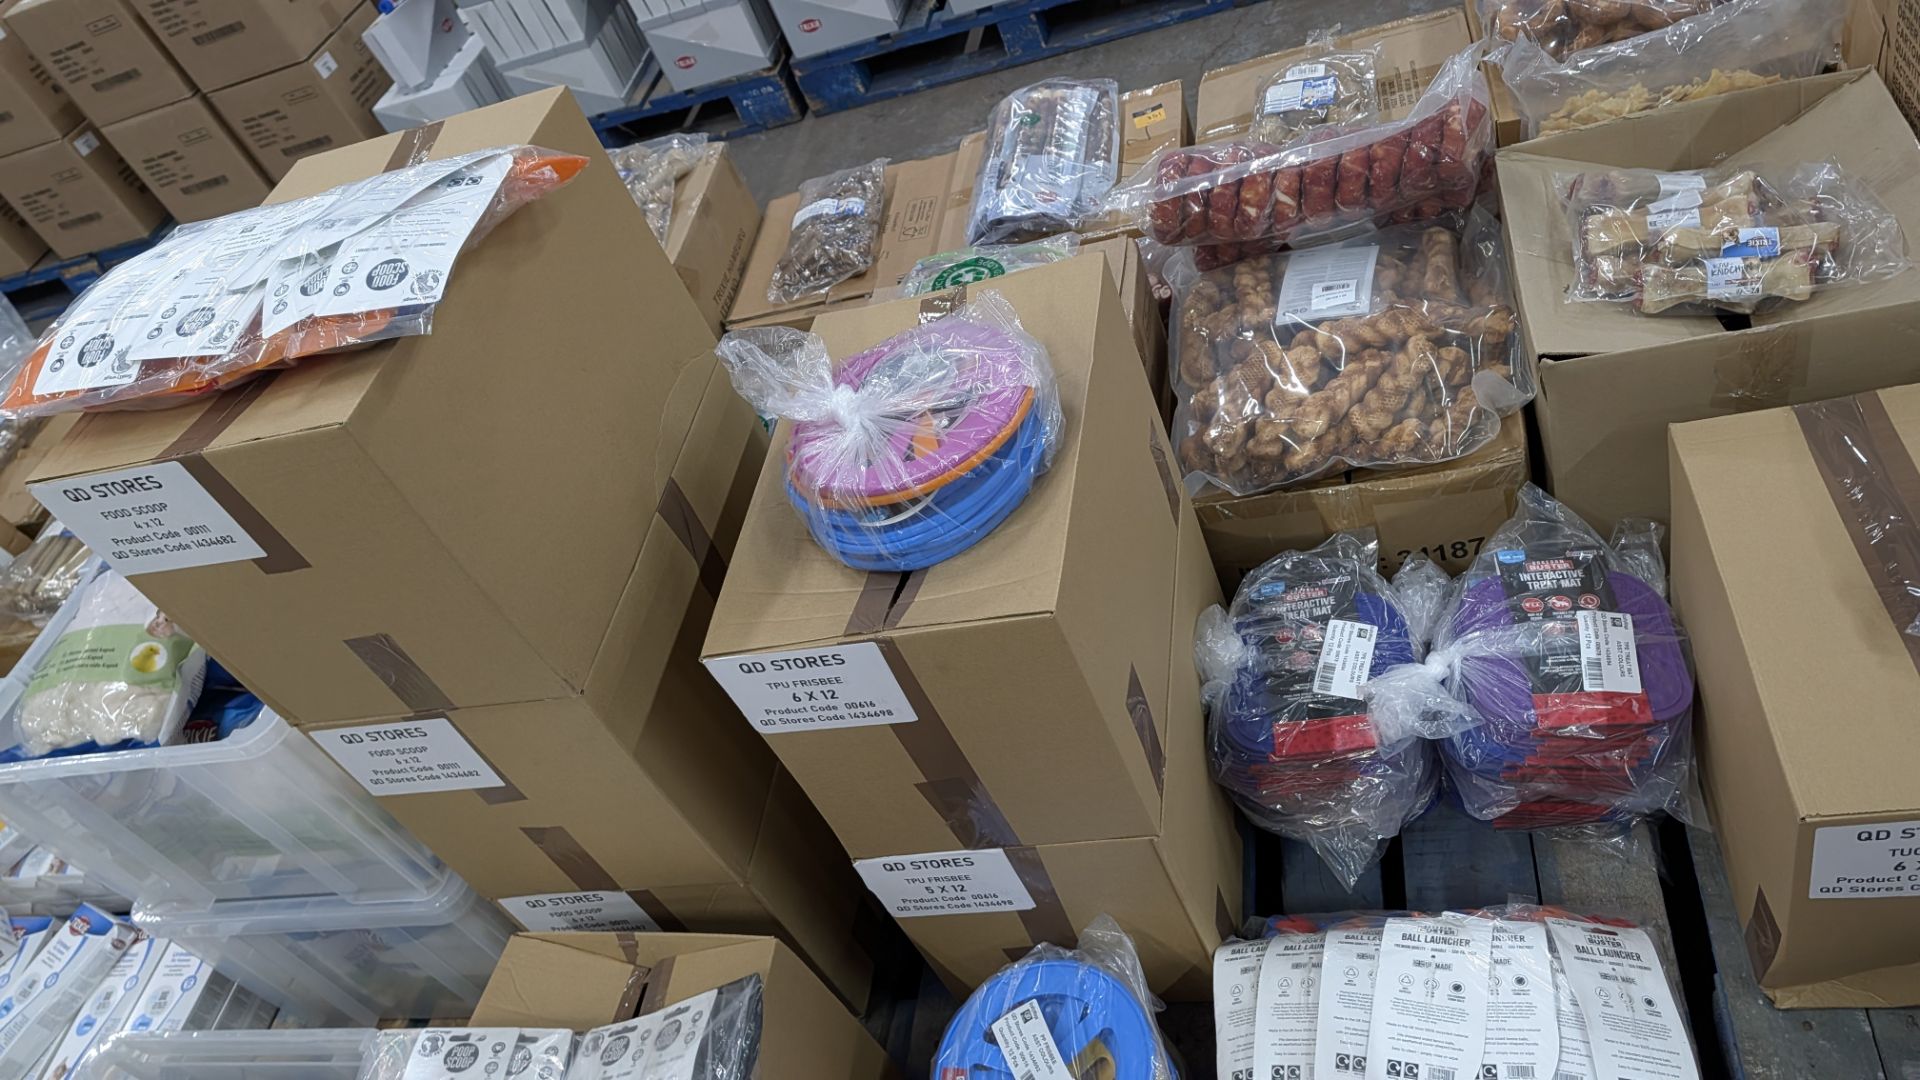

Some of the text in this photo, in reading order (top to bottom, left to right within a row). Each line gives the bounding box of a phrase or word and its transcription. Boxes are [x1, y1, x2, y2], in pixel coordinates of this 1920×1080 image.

[371, 262, 407, 276] SCOOP
[372, 273, 400, 288] FOOD
[63, 475, 163, 503] QD STORES
[101, 502, 168, 520] FOOD SCOOP
[134, 521, 143, 529] 4
[149, 517, 165, 527] 12
[111, 524, 211, 547] Product Code 00111
[112, 535, 236, 560] QD Stores Code 1434682
[1519, 570, 1584, 582] INTERACTIVE
[1526, 578, 1582, 590] TREAT MAT
[1313, 605, 1332, 617] MAT
[738, 653, 846, 674] QD STORES
[766, 676, 844, 690] TPU FRISBEE
[792, 689, 839, 702] 6 X 12
[764, 700, 876, 716] Product Code 00616
[760, 709, 894, 727] QD Stores Code 1434698
[340, 727, 428, 744] QD STORES
[368, 745, 428, 758] FOOD SCOOP
[409, 756, 422, 764] 12
[372, 762, 461, 777] Product Code 00111
[387, 776, 417, 784] Stores
[417, 773, 442, 781] Code
[1857, 829, 1891, 842] QD
[882, 857, 975, 872] QD STORES
[1893, 861, 1907, 872] 6
[904, 874, 972, 885] TPU FRISBEE
[1836, 876, 1902, 884] Product
[925, 886, 935, 894] 5
[950, 884, 967, 892] 12
[1819, 886, 1843, 894] QD
[1849, 884, 1905, 894] Stores
[525, 893, 604, 909] QD STORES
[1401, 932, 1471, 947] BALL LAUNCHER
[1231, 947, 1253, 955] BALL
[1575, 945, 1643, 962] BALL LAUNCHER
[1435, 963, 1453, 971] MADE
[451, 1045, 476, 1057] POOP
[445, 1056, 475, 1069] SCOOP
[1038, 1048, 1054, 1075] COLOURS
